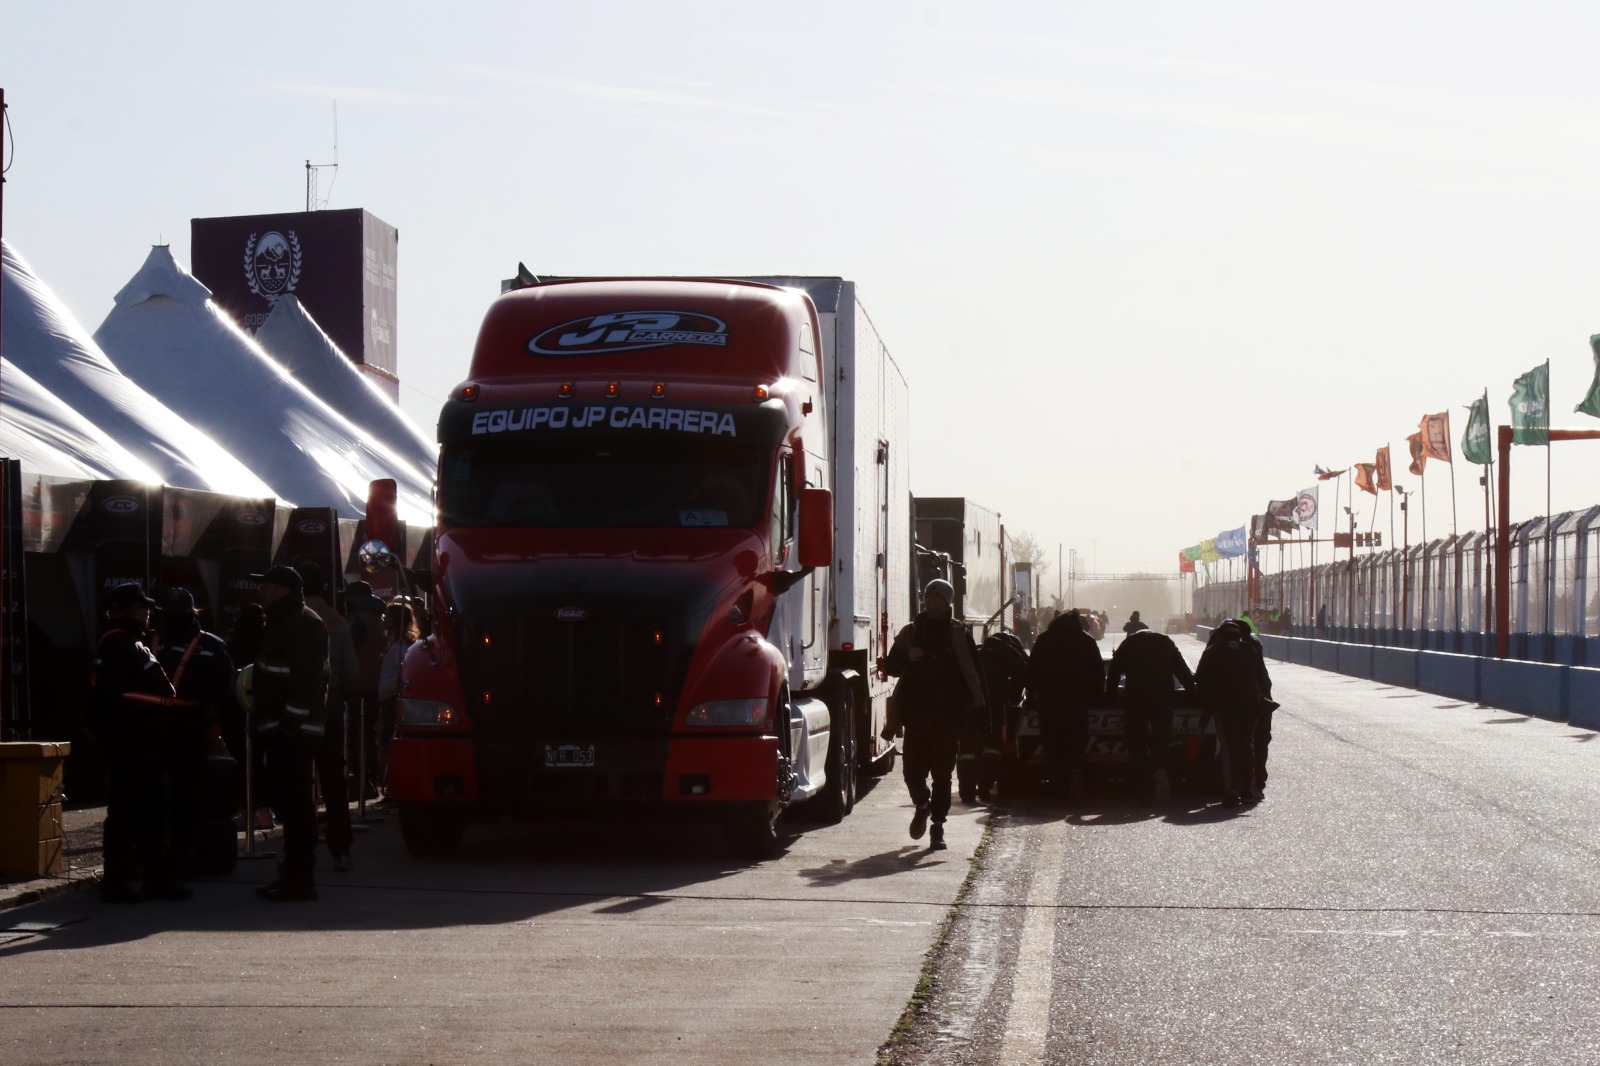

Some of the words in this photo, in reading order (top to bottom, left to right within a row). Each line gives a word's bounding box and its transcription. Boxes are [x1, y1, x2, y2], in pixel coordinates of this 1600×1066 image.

[558, 313, 682, 347] JP
[629, 330, 728, 345] CARRERA
[471, 407, 569, 435] EQUIPO
[572, 406, 607, 428] JP
[609, 407, 737, 437] CARRERA
[546, 750, 567, 763] NFR
